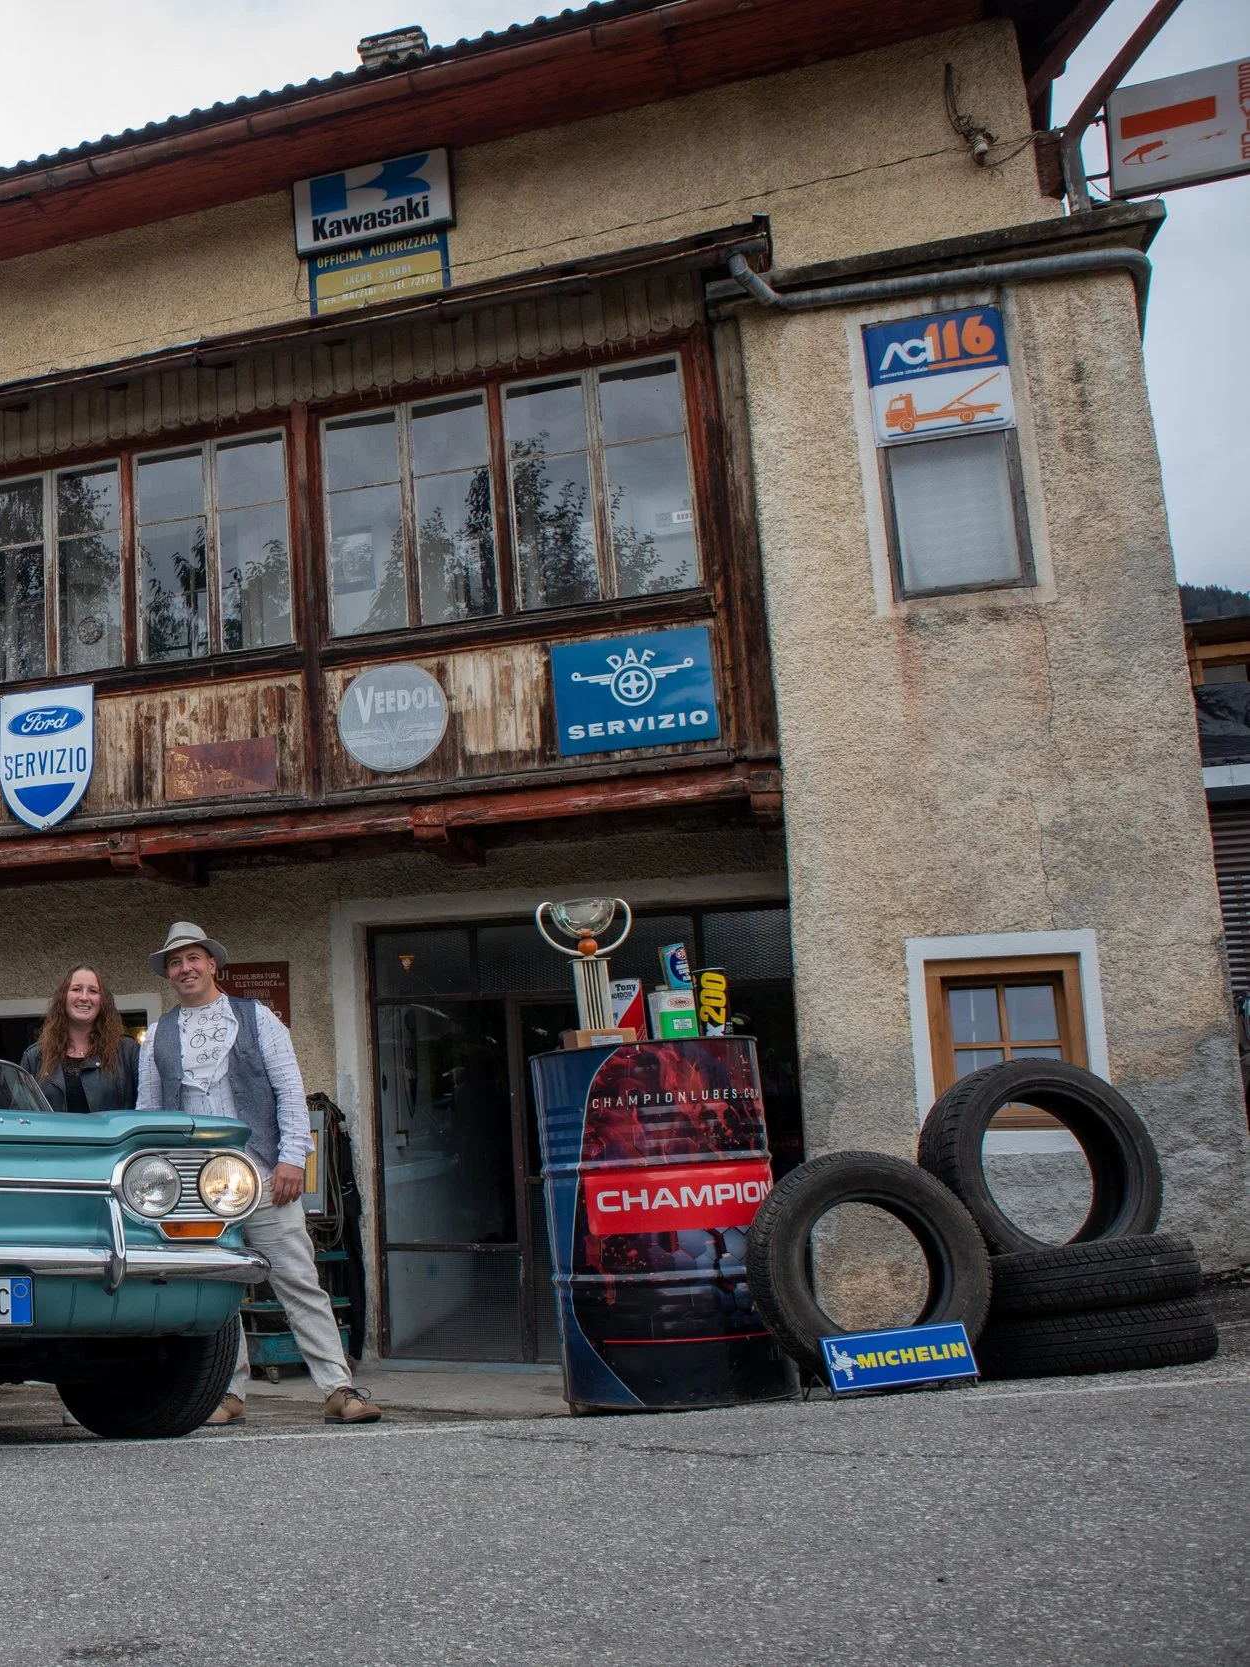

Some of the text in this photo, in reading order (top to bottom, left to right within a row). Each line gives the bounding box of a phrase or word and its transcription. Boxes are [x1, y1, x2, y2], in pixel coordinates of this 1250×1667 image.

[312, 195, 430, 242] Kawasaki
[317, 233, 439, 269] OFFICINA AUTORIZZATA
[924, 315, 996, 361] 116
[605, 648, 656, 670] DAF
[354, 685, 441, 723] VEEDOL
[21, 710, 68, 733] Ford
[567, 710, 709, 740] SERVIZIO
[4, 747, 87, 781] SERVIZIO
[232, 972, 281, 981] EQUILIBRATURA
[235, 980, 278, 988] ELETTRONICA
[856, 1342, 967, 1369] MICHELIN
